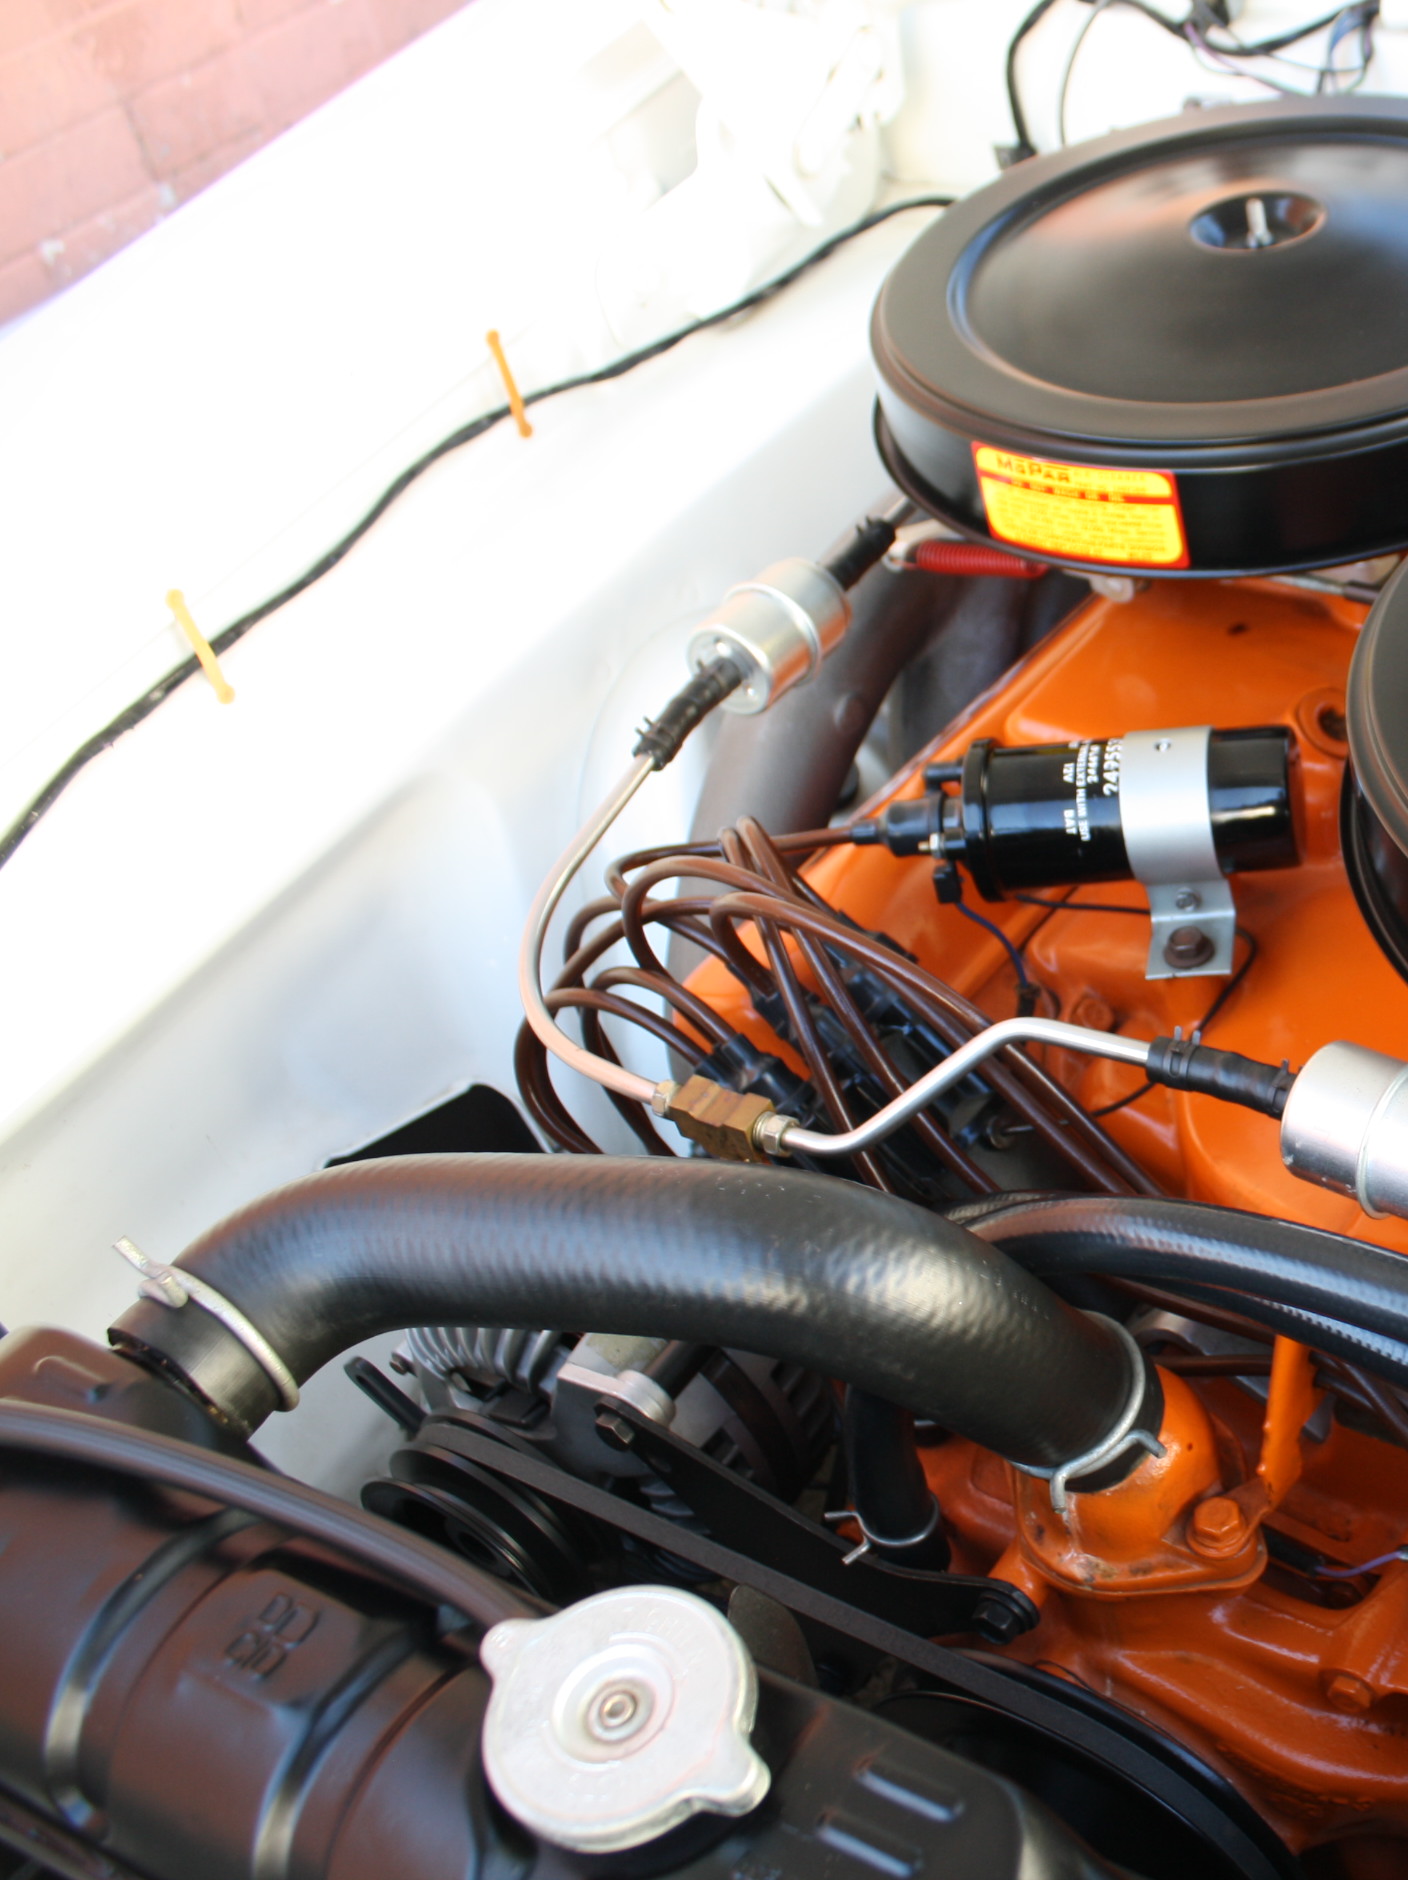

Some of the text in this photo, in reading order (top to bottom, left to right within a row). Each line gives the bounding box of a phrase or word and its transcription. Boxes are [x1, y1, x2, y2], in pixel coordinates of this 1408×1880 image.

[1076, 788, 1087, 818] WITH
[1064, 809, 1077, 834] BAT
[1078, 819, 1091, 841] USE
